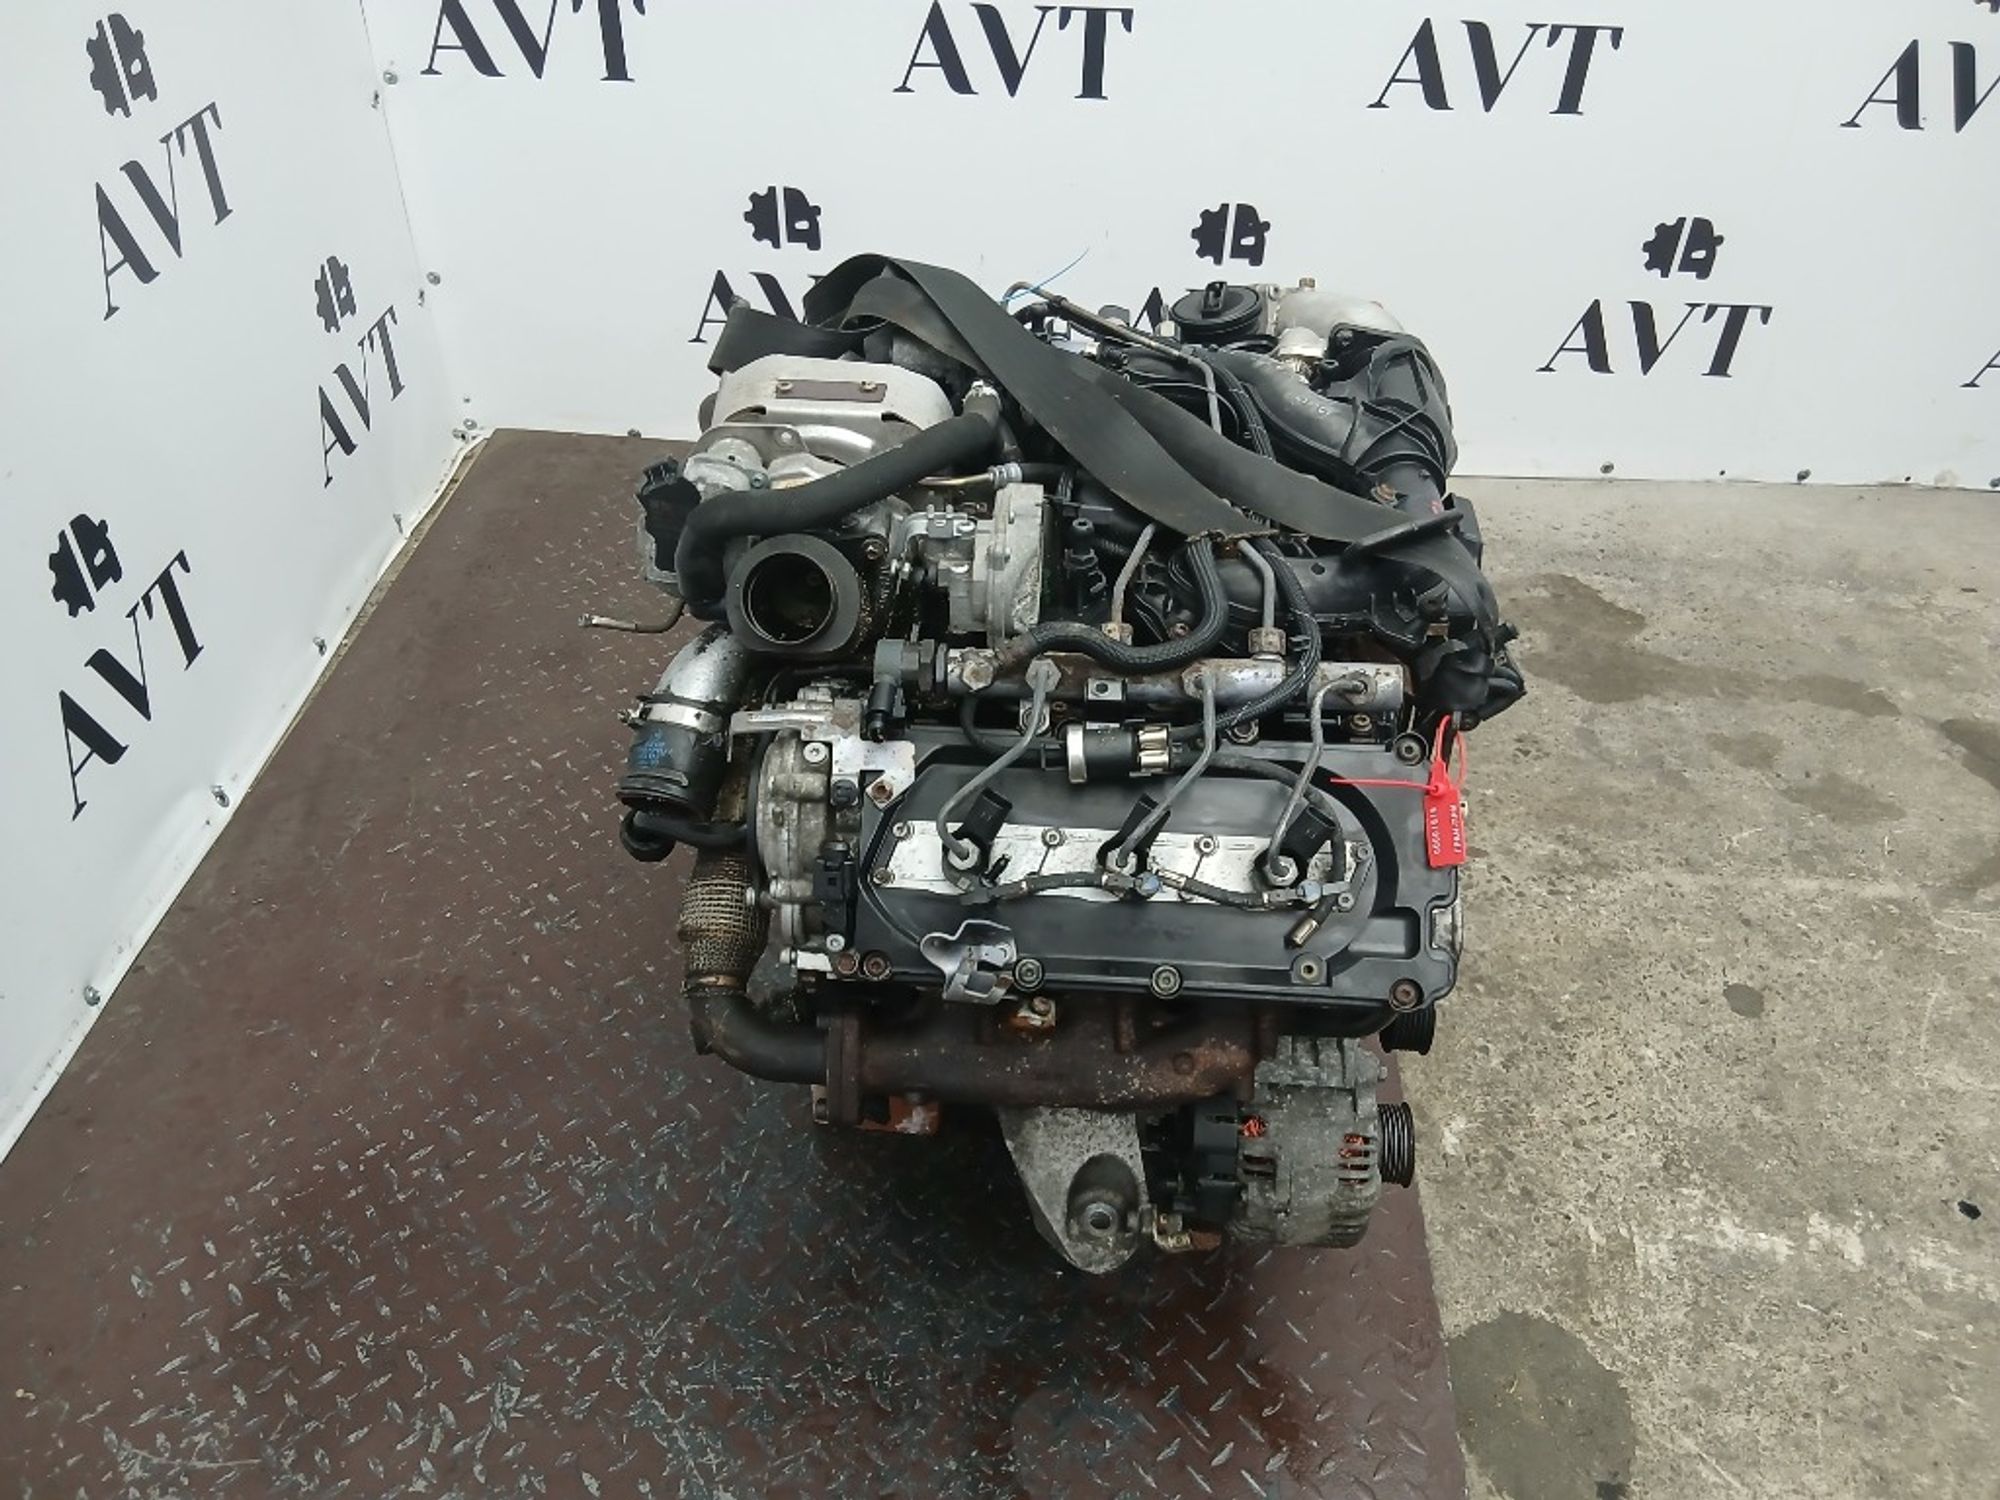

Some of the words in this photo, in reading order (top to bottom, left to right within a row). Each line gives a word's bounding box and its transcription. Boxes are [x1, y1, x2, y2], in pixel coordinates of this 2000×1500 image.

[420, 0, 646, 82] AVT
[893, 0, 1133, 100] AVT
[1367, 18, 1624, 115] AVT
[1840, 39, 2000, 133] AV
[96, 102, 233, 321] AVT
[688, 270, 826, 343] AV
[1536, 299, 1772, 378] AVT
[318, 305, 405, 488] AVT
[59, 549, 204, 821] AVT
